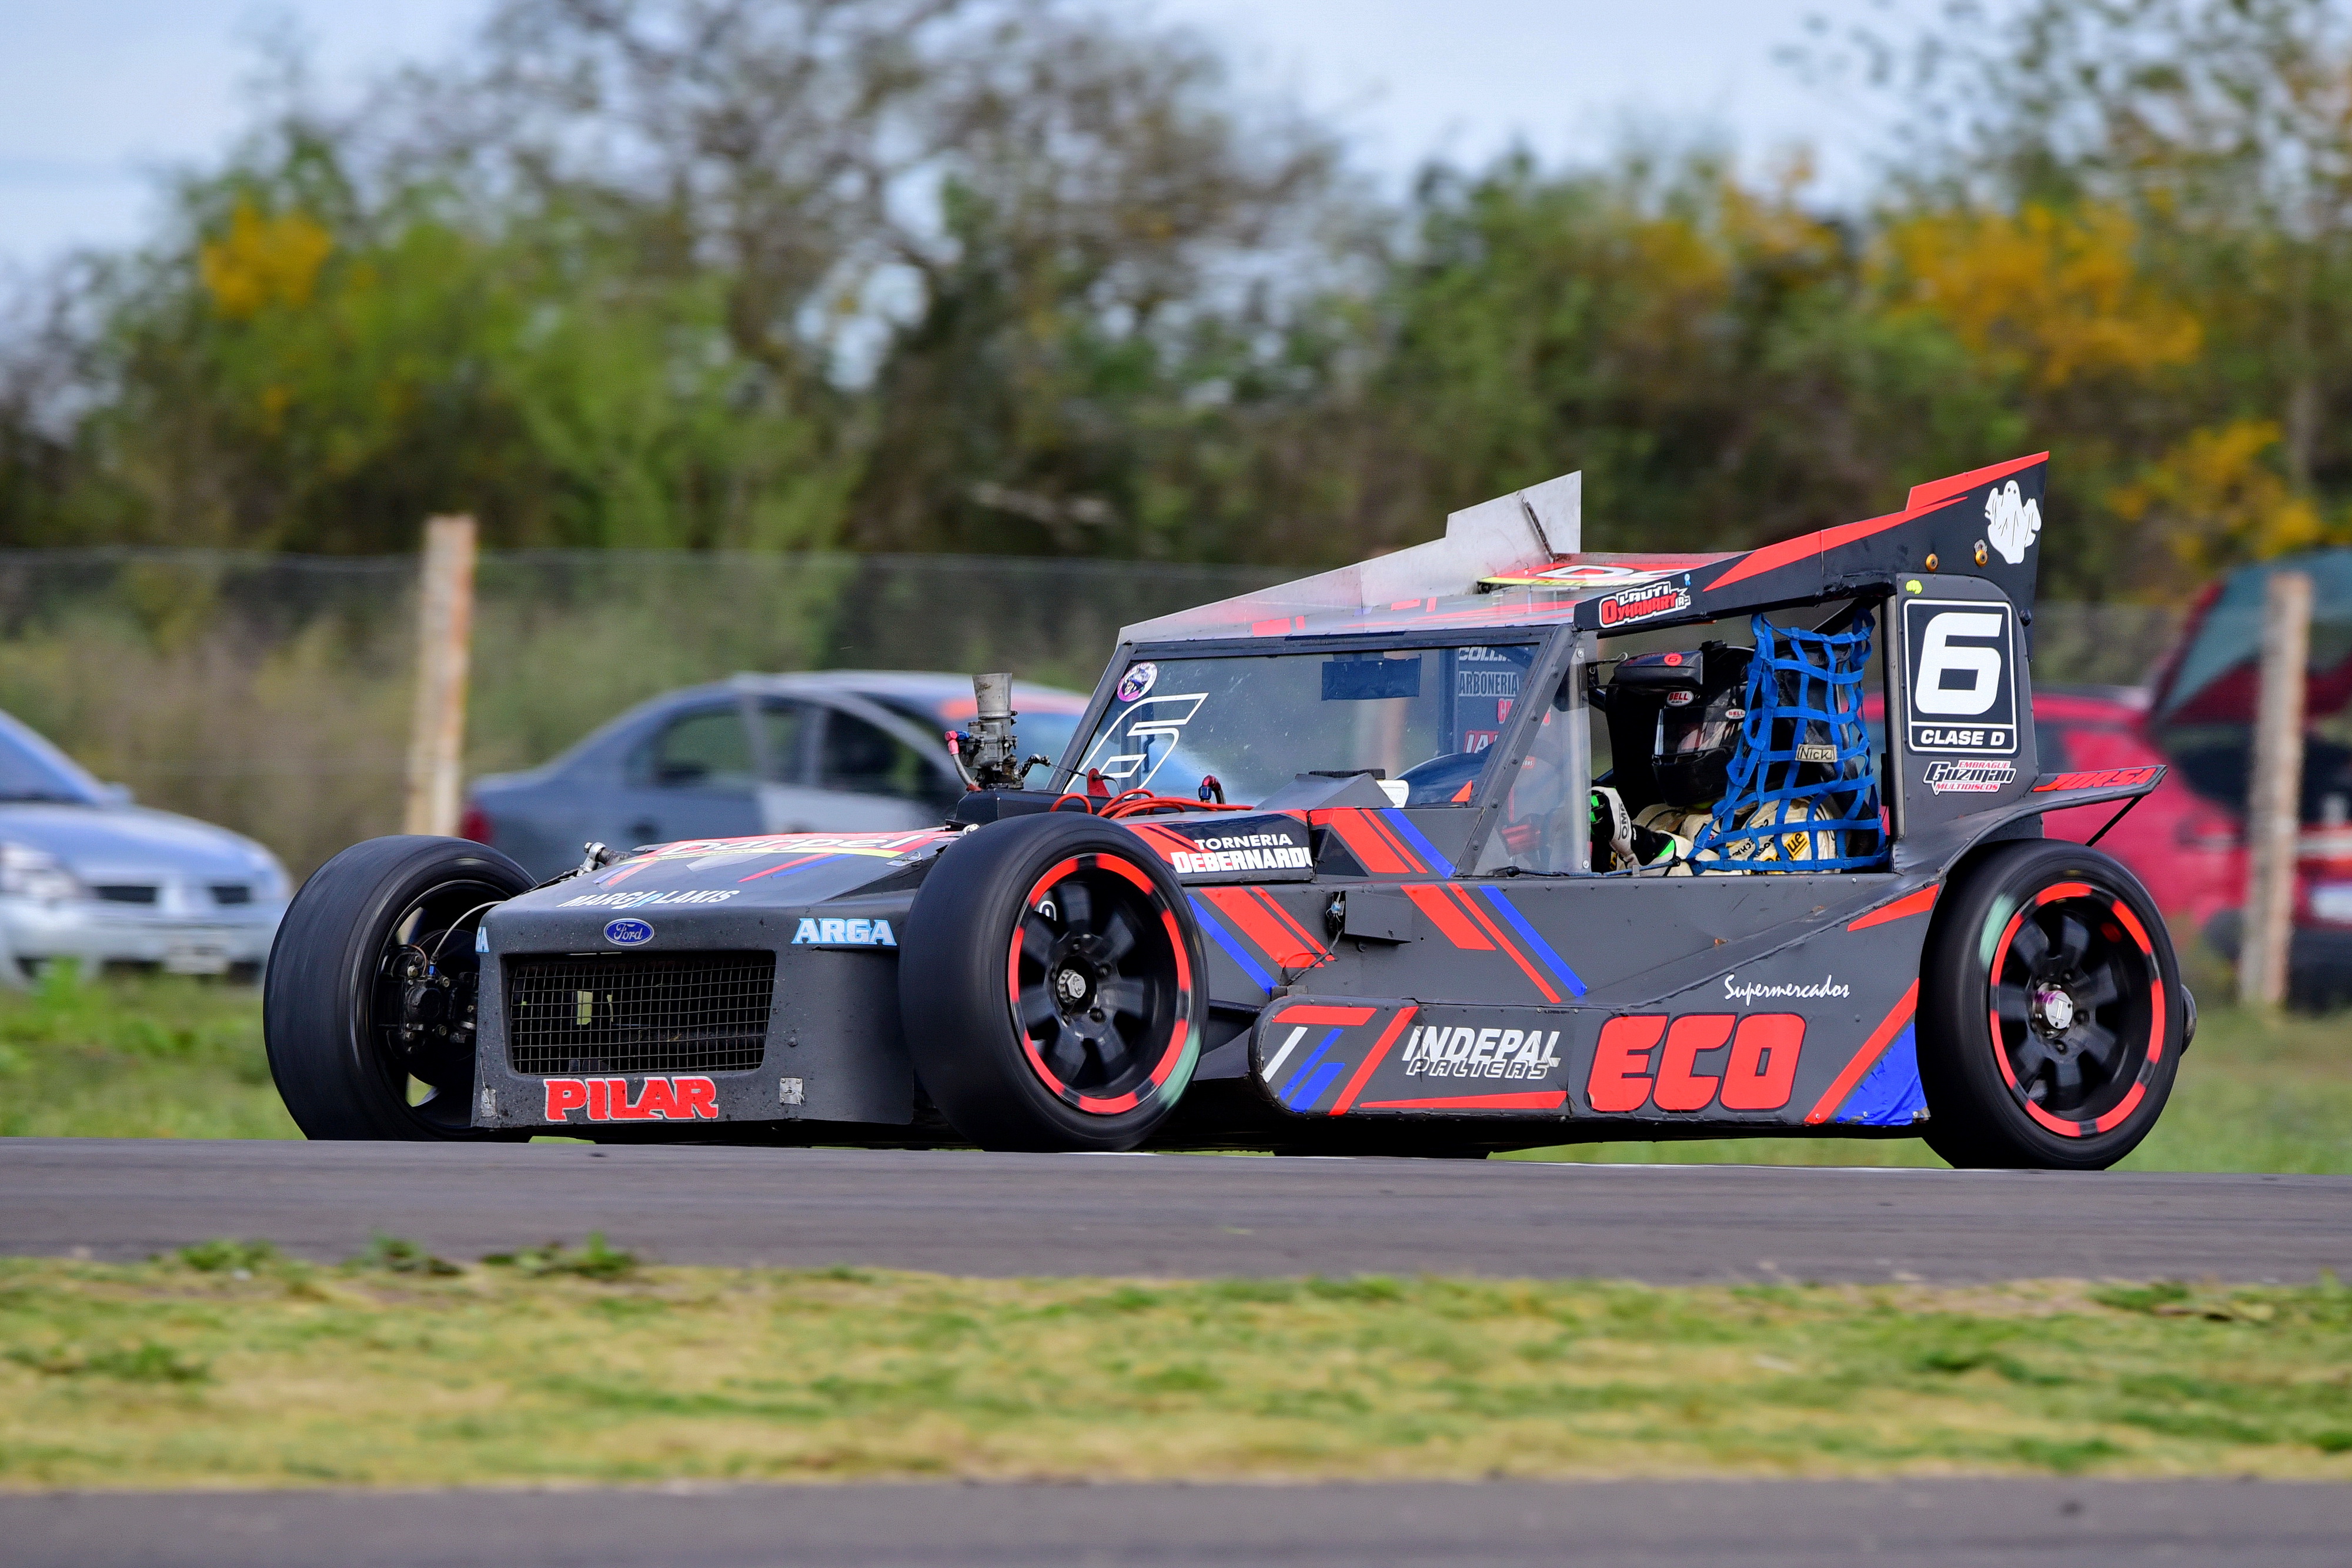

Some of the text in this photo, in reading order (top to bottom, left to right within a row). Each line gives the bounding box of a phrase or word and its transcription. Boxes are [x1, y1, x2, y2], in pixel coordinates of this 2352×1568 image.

[1619, 584, 1670, 606] LAUTI
[1915, 612, 2003, 715] 6
[1669, 692, 1689, 701] BELL
[1920, 730, 2006, 746] CLASE D
[1925, 763, 2016, 783] Guzman
[1958, 761, 2010, 769] EMBRAGUE
[659, 834, 925, 856] Darpel
[1194, 834, 1294, 851] TORNERIA
[613, 922, 643, 941] Ford
[791, 918, 897, 945] ARGA
[1724, 974, 1850, 1007] Supermercados
[1402, 1025, 1561, 1067] INDEPAL
[1406, 1057, 1551, 1080] PALIERS
[1585, 1012, 1808, 1112] ECO
[543, 1076, 719, 1122] PILAR
